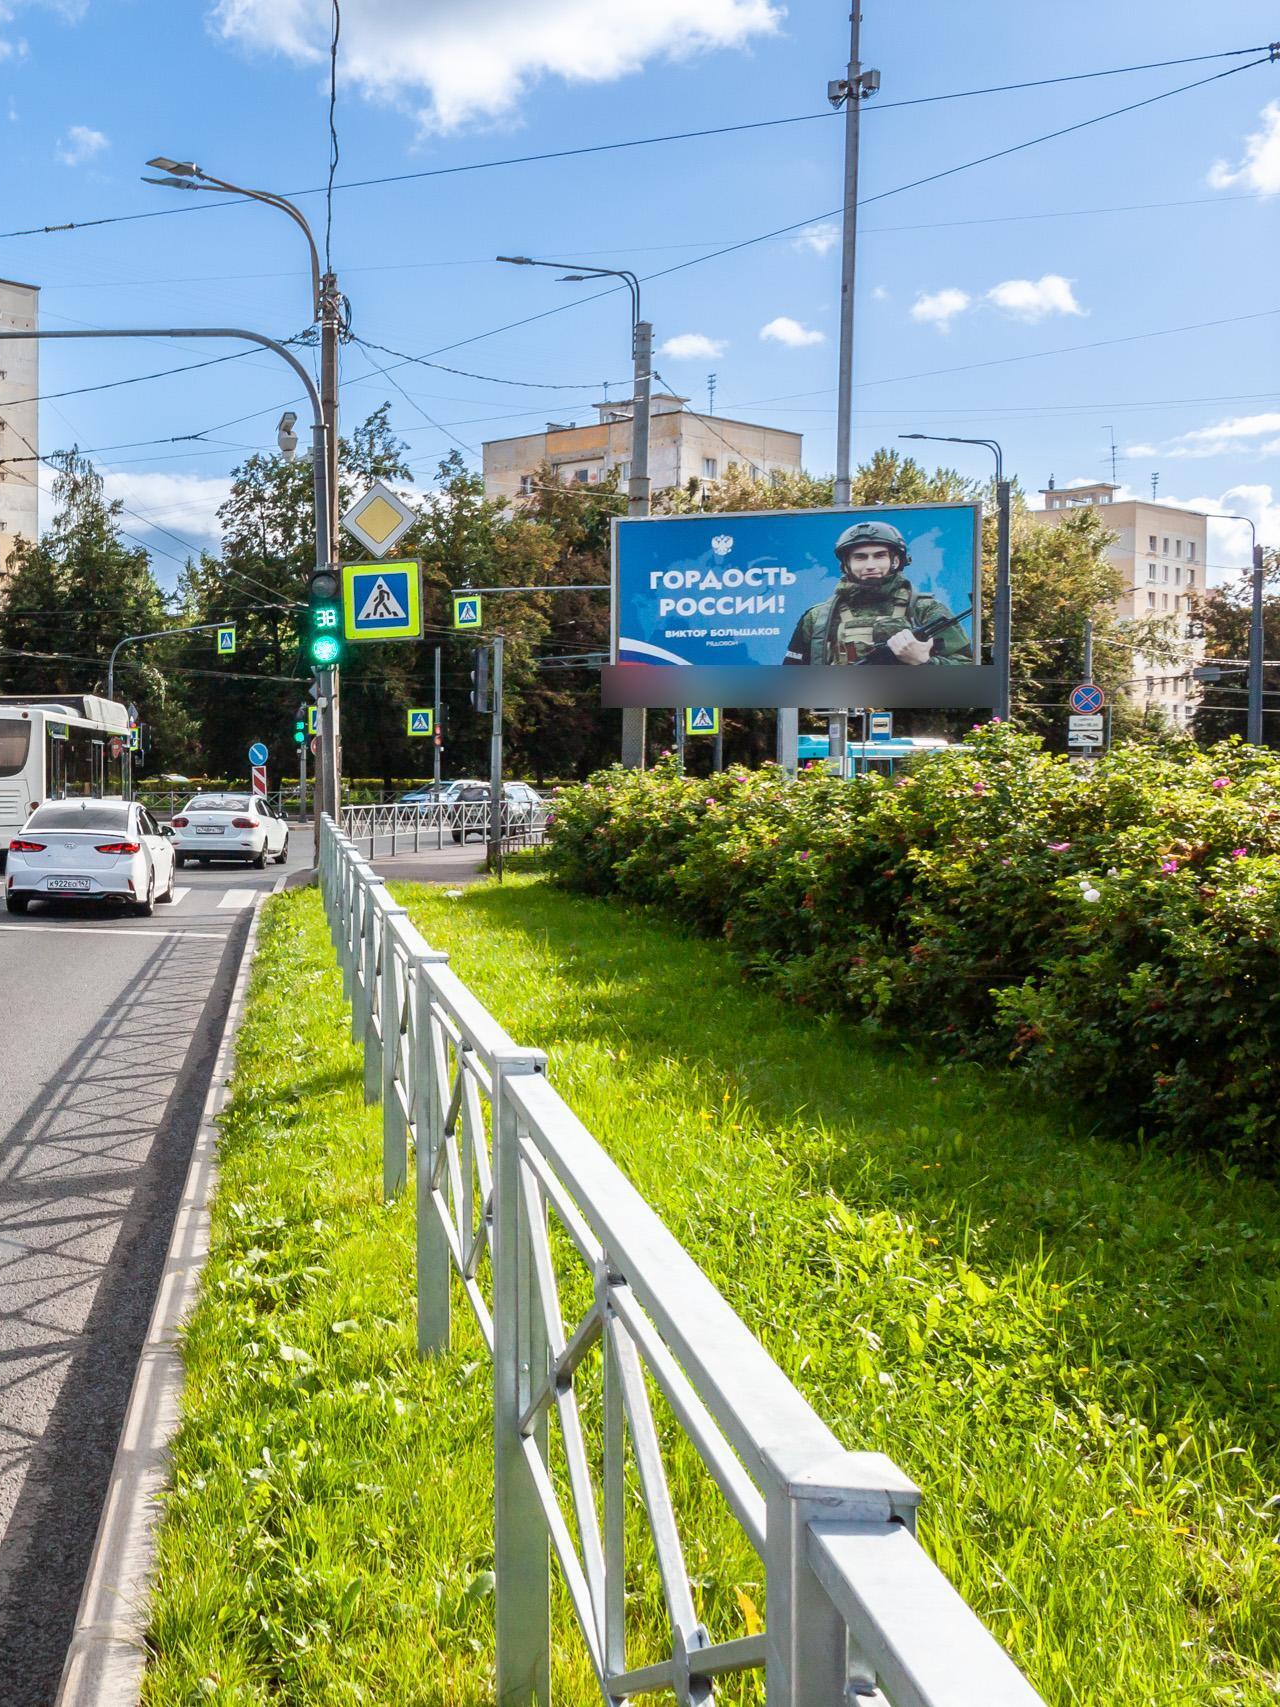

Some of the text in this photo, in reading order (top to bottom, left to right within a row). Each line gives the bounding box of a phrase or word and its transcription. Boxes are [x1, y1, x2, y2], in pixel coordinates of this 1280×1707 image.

[649, 567, 797, 591] ГОРДОСТЬ
[659, 595, 785, 617] РОССИИ!
[316, 609, 336, 627] 38
[665, 627, 780, 638] ВИКТОР БОЛЬШАКОВ
